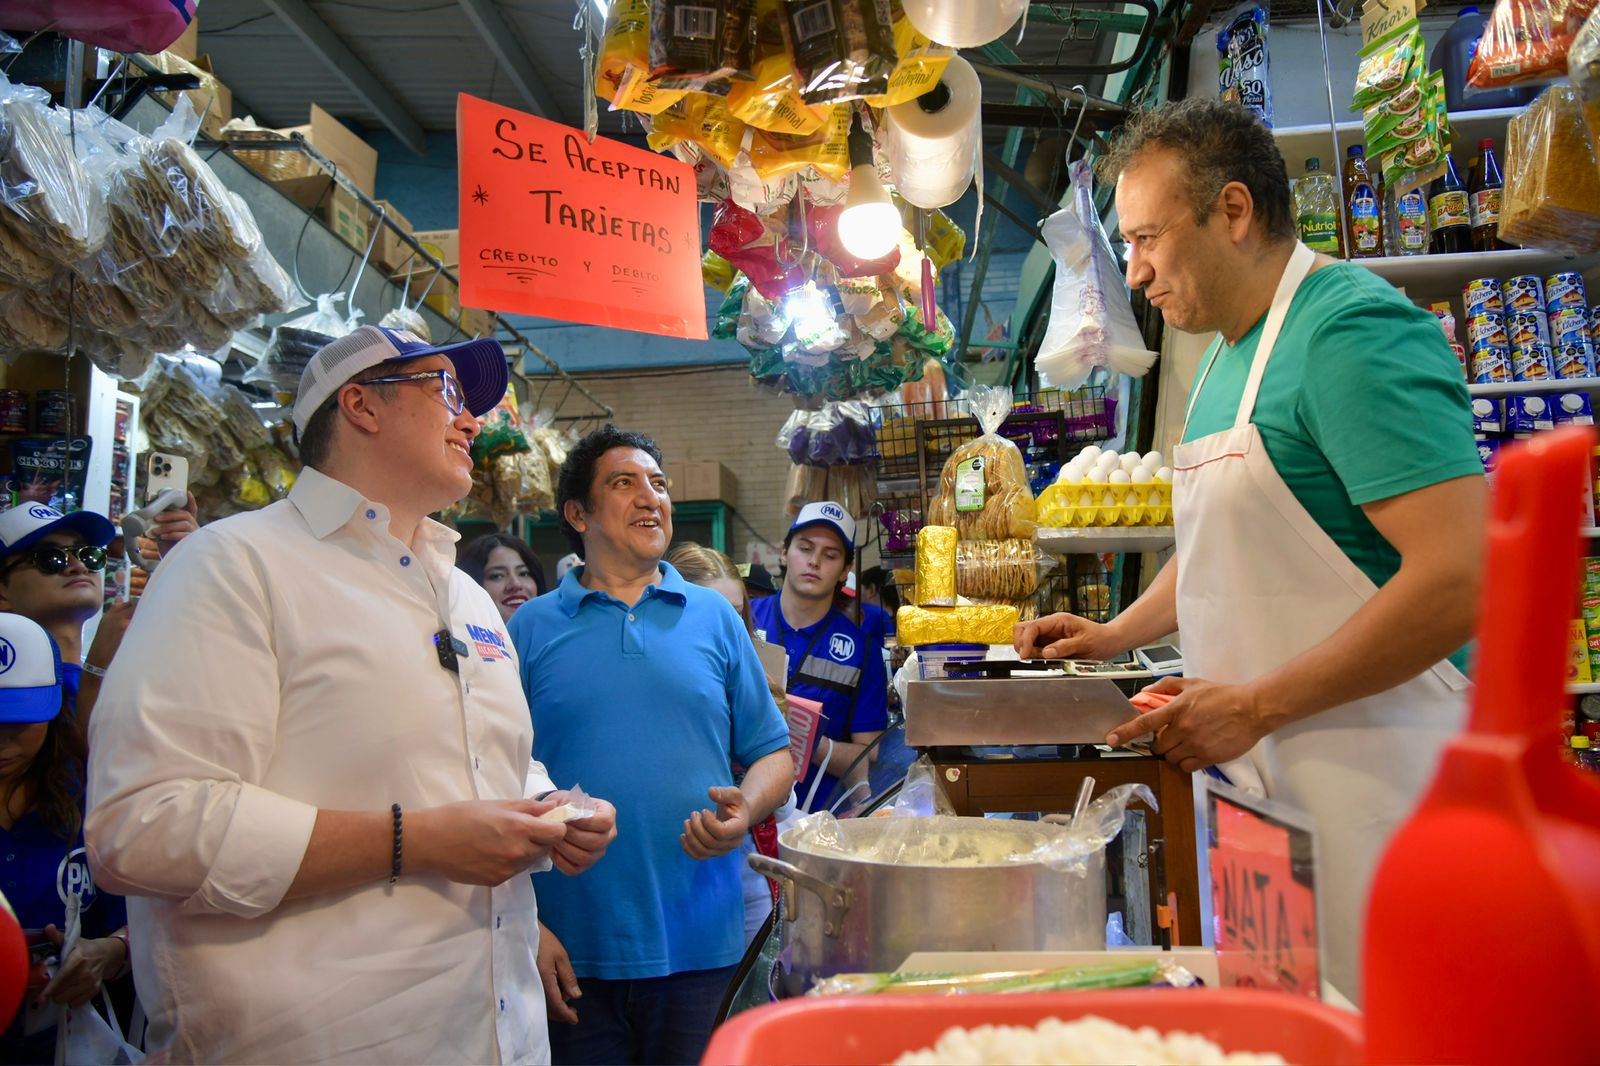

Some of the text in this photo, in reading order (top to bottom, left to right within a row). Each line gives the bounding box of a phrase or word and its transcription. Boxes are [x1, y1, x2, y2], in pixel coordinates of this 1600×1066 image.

[1367, 6, 1410, 42] Knorr
[1220, 46, 1264, 88] Vaso
[1242, 80, 1262, 95] 50
[492, 118, 681, 195] SE ACEPTAN
[479, 248, 661, 283] CREDITO Y DEBITO
[823, 506, 842, 519] PAN
[830, 638, 852, 657] PAN
